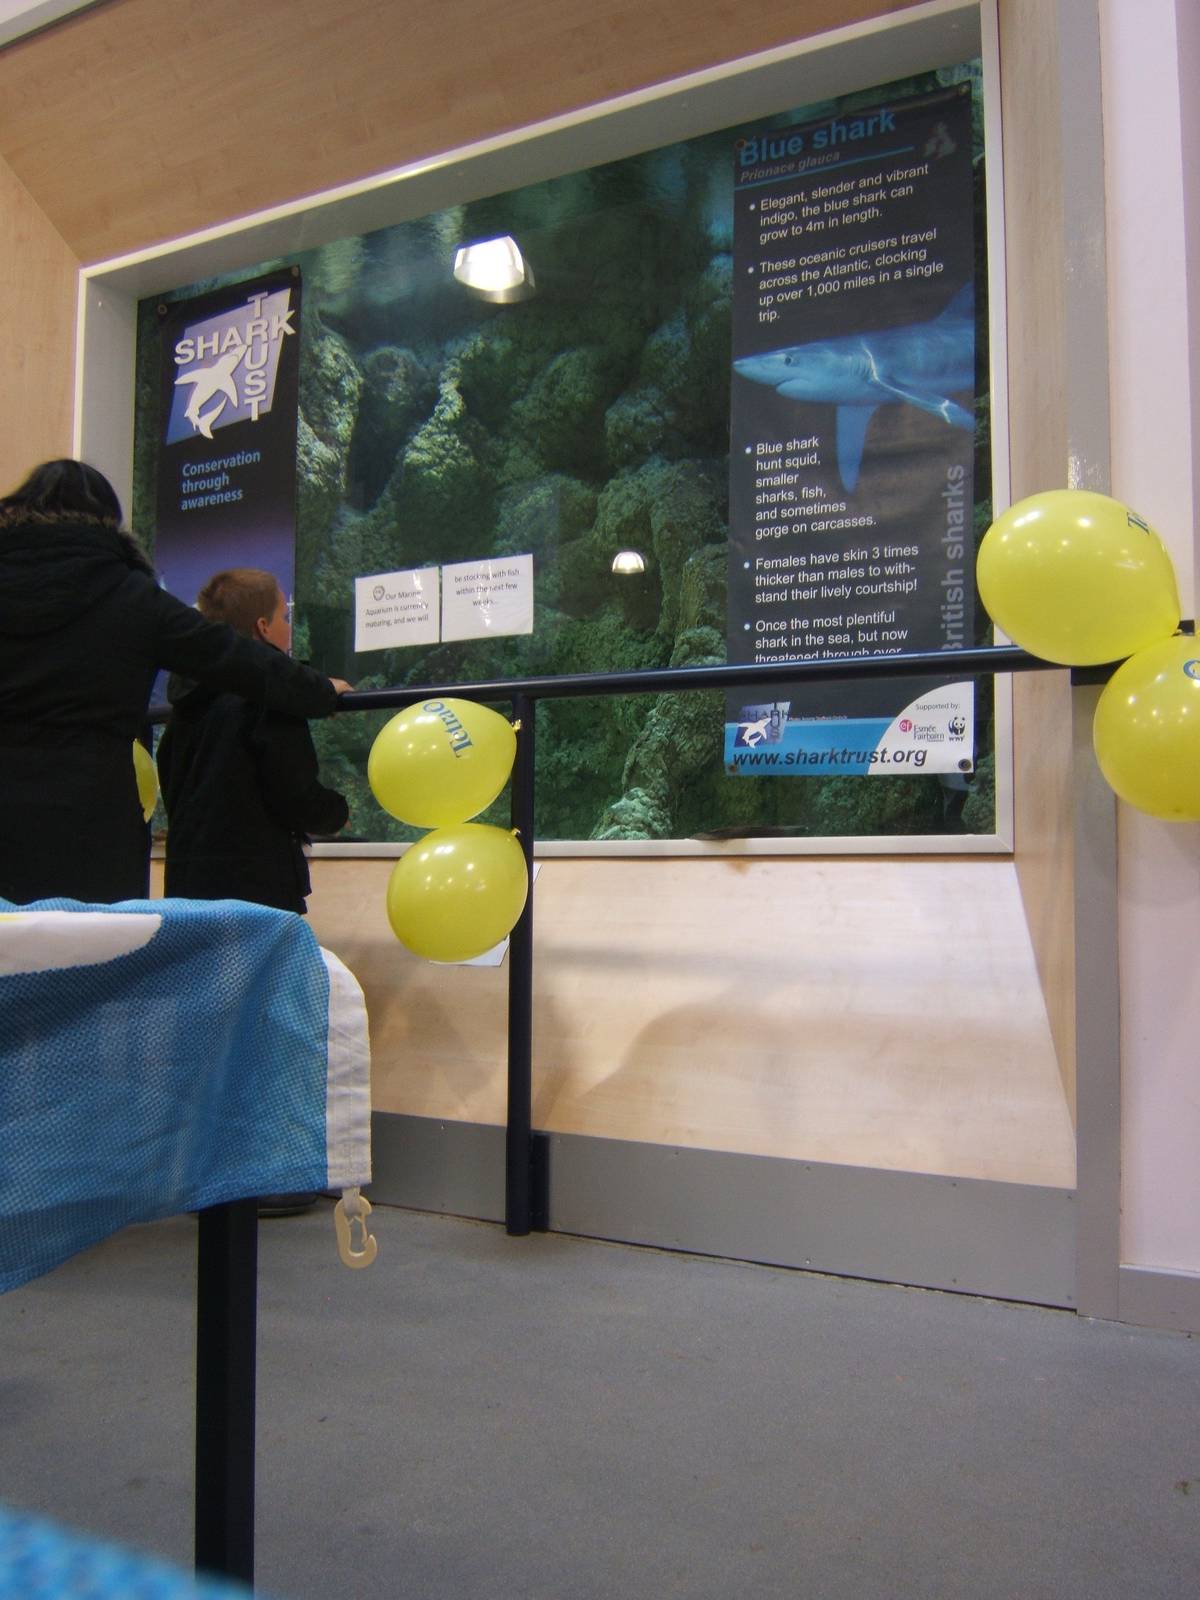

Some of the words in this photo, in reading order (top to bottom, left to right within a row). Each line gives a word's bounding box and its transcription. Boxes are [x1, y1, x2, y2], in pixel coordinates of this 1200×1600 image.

[740, 136, 803, 167] Blue
[813, 109, 896, 149] shark
[741, 163, 795, 182] Prionace
[799, 152, 841, 170] glauca
[760, 193, 808, 211] Elegant,
[811, 180, 855, 199] slender
[859, 173, 882, 189] and
[886, 164, 929, 183] vibrant
[760, 211, 798, 227] indigo,
[802, 203, 820, 217] the
[824, 198, 849, 212] blue
[853, 189, 887, 206] shark
[890, 185, 913, 199] can
[759, 230, 788, 245] grow
[791, 222, 803, 236] to
[806, 219, 824, 232] 4m
[828, 215, 839, 227] in
[842, 207, 882, 226] length.
[760, 258, 796, 273] These
[799, 248, 845, 266] oceanic
[849, 235, 898, 255] cruisers
[901, 228, 937, 244] travel
[759, 273, 798, 289] across
[801, 268, 820, 282] the
[823, 260, 871, 278] Atlantic,
[875, 248, 927, 267] clocking
[759, 295, 773, 307] up
[776, 288, 802, 302] over
[807, 280, 840, 298] 1,000
[844, 274, 875, 289] miles
[879, 270, 890, 282] in
[893, 269, 902, 280] a
[906, 261, 944, 279] single
[759, 309, 780, 322] trip.
[174, 310, 296, 365] SHARK
[244, 291, 269, 421] TRUST
[756, 443, 783, 455] Blue
[786, 436, 819, 451] shark
[183, 450, 261, 476] Conservation
[756, 458, 782, 471] hunt
[785, 453, 821, 469] squid,
[182, 473, 230, 494] through
[756, 473, 799, 488] smaller
[181, 488, 243, 511] awareness
[756, 489, 798, 504] sharks,
[802, 487, 826, 499] fish,
[756, 508, 777, 521] and
[781, 501, 847, 518] sometimes
[941, 464, 964, 559] sharks
[756, 525, 789, 540] gorge
[792, 523, 807, 534] on
[811, 515, 877, 531] carcasses.
[756, 557, 806, 570] Females
[810, 552, 839, 564] have
[843, 548, 868, 561] skin
[872, 547, 880, 559] 3
[884, 544, 919, 558] times
[455, 575, 462, 583] be
[492, 570, 506, 579] with
[507, 568, 520, 576] fish
[755, 573, 794, 587] thicker
[798, 570, 824, 583] than
[827, 566, 865, 580] males
[869, 565, 881, 576] to
[884, 562, 916, 575] with-
[385, 592, 396, 600] Our
[456, 586, 475, 595] within
[476, 585, 488, 593] the
[505, 583, 517, 591] few
[755, 589, 787, 604] stand
[791, 586, 817, 600] their
[821, 583, 851, 600] lively
[855, 579, 918, 595] courtship!
[365, 606, 393, 616] Aquarium
[394, 617, 405, 625] and
[756, 619, 787, 632] Once
[790, 618, 809, 630] the
[813, 615, 842, 628] most
[846, 611, 895, 627] plentiful
[755, 636, 788, 649] shark
[791, 634, 801, 646] in
[805, 633, 824, 645] the
[828, 632, 854, 645] sea,
[858, 630, 878, 642] but
[882, 629, 908, 641] now
[915, 703, 949, 711] Supported
[733, 747, 928, 767] www.sharktrust.org
